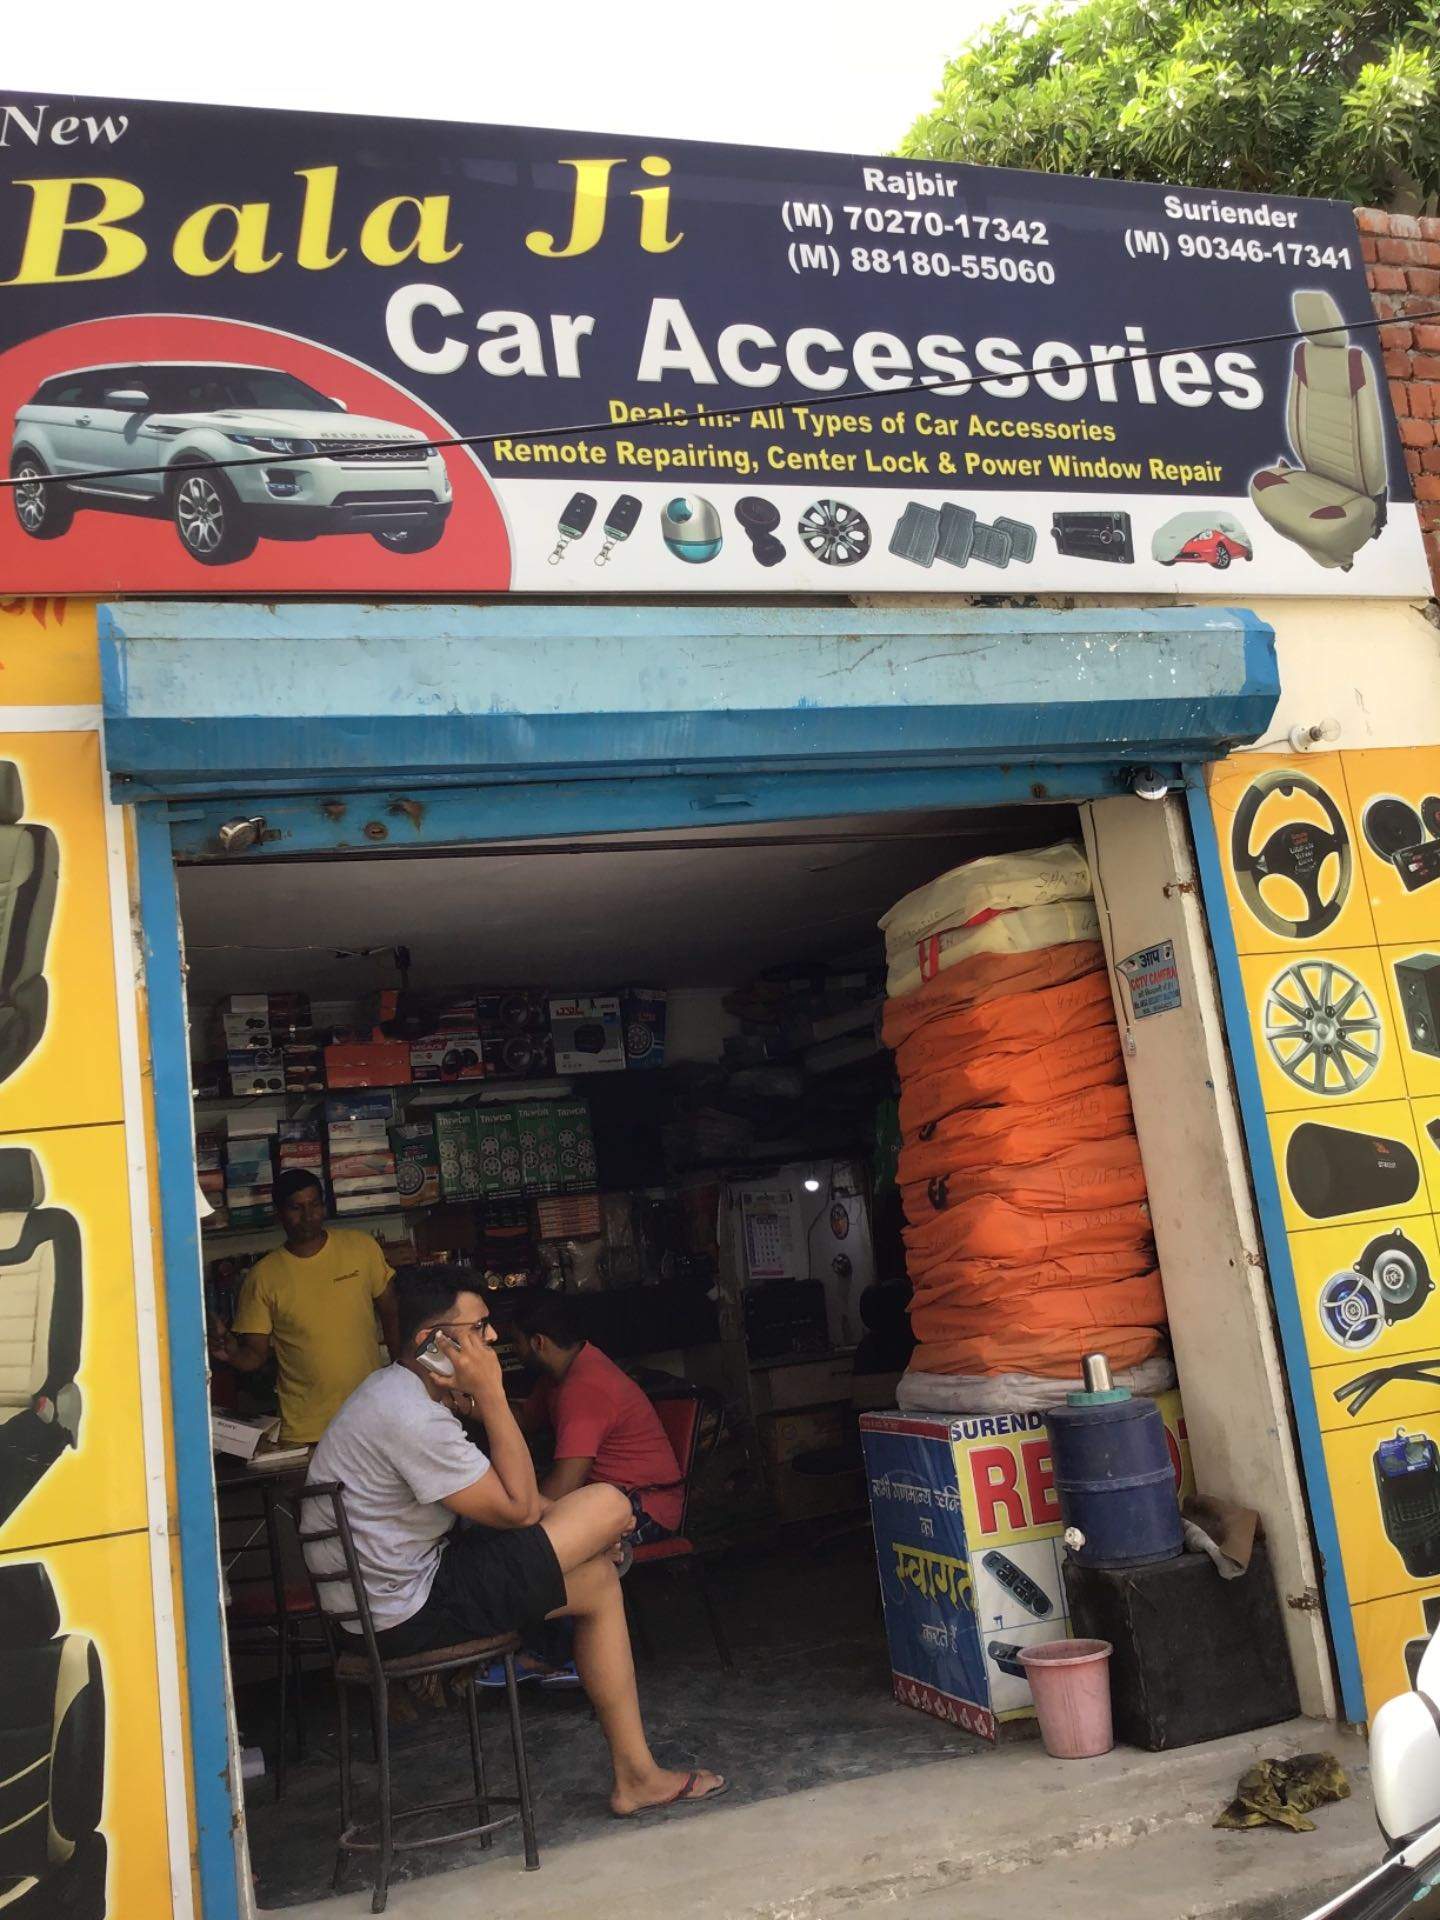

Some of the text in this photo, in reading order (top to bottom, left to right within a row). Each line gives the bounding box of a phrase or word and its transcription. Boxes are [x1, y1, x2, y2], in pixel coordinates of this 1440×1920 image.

[0, 105, 128, 147] New
[862, 167, 958, 200] Rajbir
[0, 156, 684, 286] Bala Ji
[781, 201, 1049, 245] (M) 70270-17342
[1164, 195, 1297, 228] Suriender
[788, 242, 1055, 285] (M) 88180-55060
[1124, 229, 1351, 270] (M) 90346-17341
[385, 283, 1265, 411] Car Accessories
[609, 400, 687, 426] Deals
[750, 408, 785, 430] All
[793, 408, 872, 437] Types
[881, 412, 905, 434] of
[915, 412, 959, 436] Car
[968, 414, 1117, 442] Accessories
[493, 440, 1222, 486] Remote Repairing, Center Lock & Power Window Repair
[1138, 949, 1160, 968] आप
[951, 1411, 1048, 1442] SUREND
[892, 1542, 977, 1612] स्वागत
